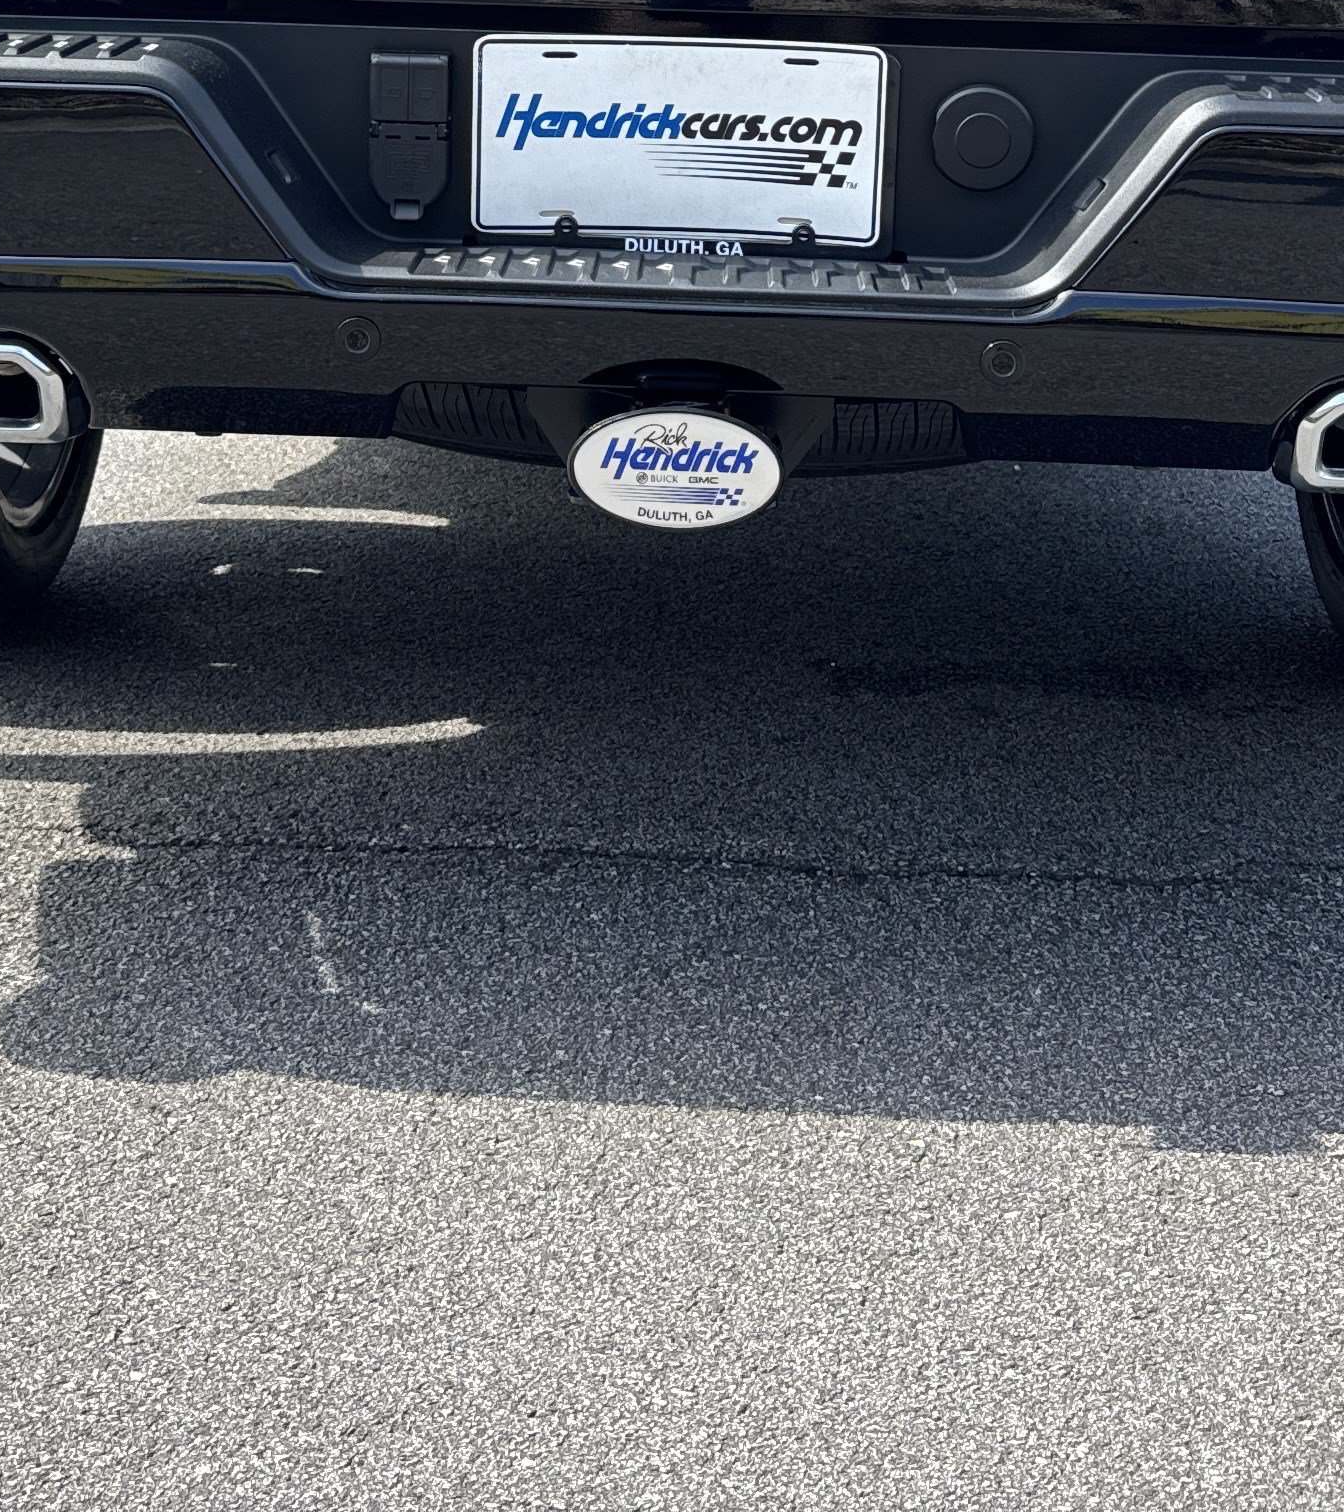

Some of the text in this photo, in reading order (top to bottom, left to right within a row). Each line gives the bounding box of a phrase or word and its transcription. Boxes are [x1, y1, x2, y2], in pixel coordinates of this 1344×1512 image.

[495, 93, 863, 150] Hendrickcars.com
[715, 240, 744, 257] GA
[634, 422, 688, 454] Rick
[600, 437, 759, 480] Hendrick
[650, 475, 719, 484] BUICK GMC
[637, 506, 714, 523] DULUTH, GA
